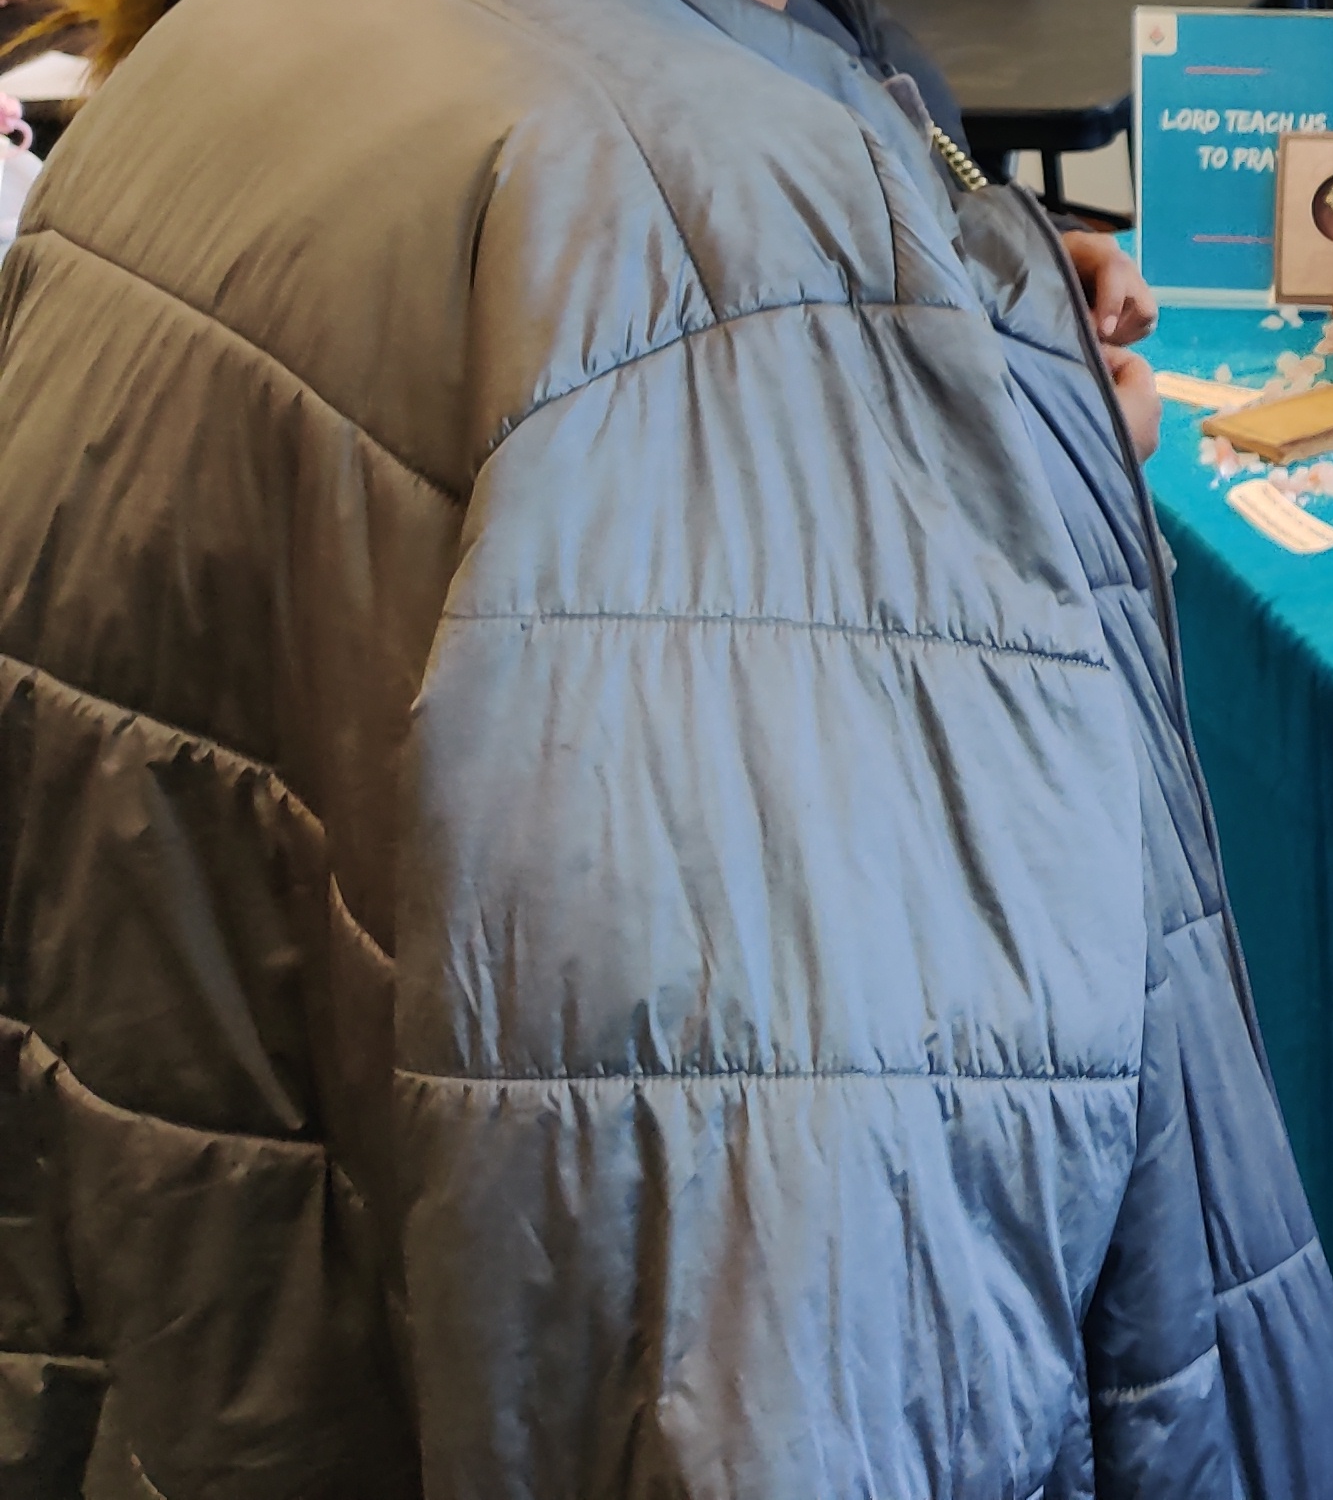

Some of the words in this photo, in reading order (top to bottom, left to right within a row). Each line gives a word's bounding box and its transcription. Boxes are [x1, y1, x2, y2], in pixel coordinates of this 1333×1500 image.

[1161, 108, 1221, 134] LORD
[1225, 109, 1295, 135] TEACH
[1299, 112, 1328, 133] US
[1198, 145, 1229, 170] TO
[1232, 147, 1279, 173] PRA
